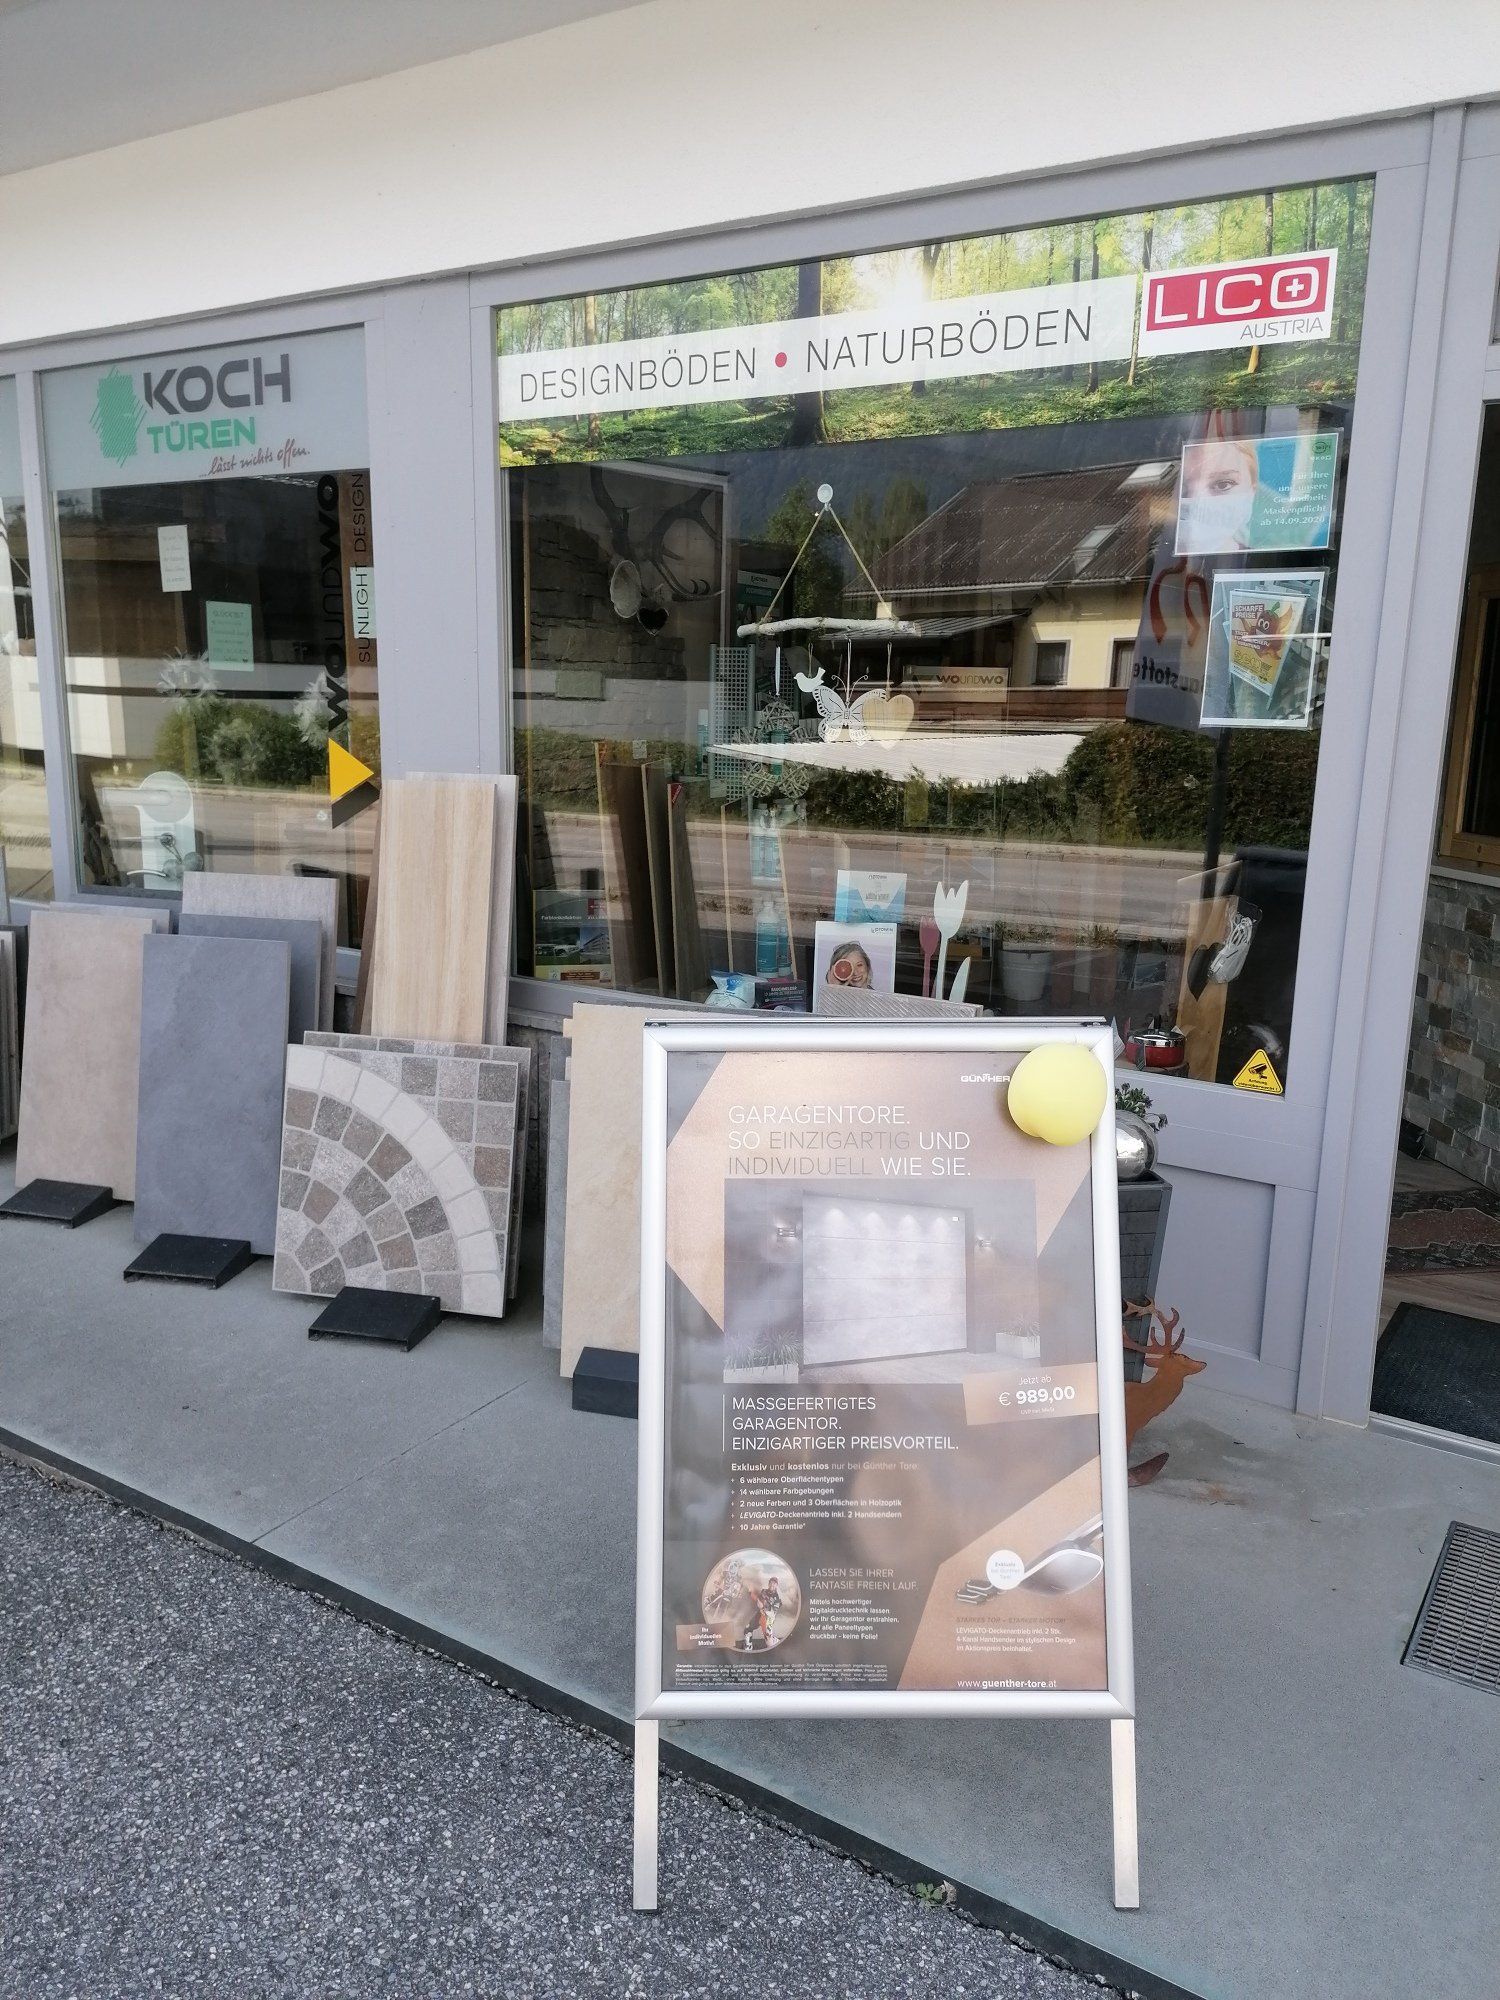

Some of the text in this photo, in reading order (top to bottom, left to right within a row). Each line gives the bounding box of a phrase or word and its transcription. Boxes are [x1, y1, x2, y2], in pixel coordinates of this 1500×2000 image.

[1154, 266, 1319, 323] LICO
[1240, 317, 1323, 340] AUSTRIA
[519, 304, 1093, 404] DESIGNBÖDEN NATURBÖDEN
[143, 354, 291, 415] KOCH
[147, 416, 256, 454] TÜREN
[240, 447, 273, 469] nichts
[277, 439, 310, 469] offen.
[1273, 494, 1327, 503] Gesundheit:
[1264, 505, 1326, 515] Maskenpflicht
[1261, 516, 1324, 526] ab 14.09.2020
[351, 473, 372, 663] SUNLIGHT DESIGN
[960, 1073, 1011, 1083] GÜNTHER
[728, 1105, 911, 1125] GARAGENTORE.
[729, 1131, 971, 1150] SO EINZIGARTIG UND
[729, 1157, 971, 1176] INDIVIDUELL WIE SIE.
[1019, 1375, 1051, 1385] Jetzt ab
[998, 1385, 1075, 1406] € 989,00
[732, 1397, 876, 1411] MASSGEFERTIGTES
[732, 1417, 842, 1430] GARAGENTOR.
[732, 1436, 960, 1450] EINZIGARTIGER PREISVORTEIL.
[731, 1463, 767, 1471] Exklusiv
[770, 1463, 785, 1471] und
[787, 1462, 829, 1470] kostenlos
[863, 1462, 897, 1470] Günther
[781, 1476, 844, 1484] Oberflächentypen
[783, 1487, 834, 1496] Farbgebungen
[766, 1499, 791, 1507] Farben
[793, 1499, 806, 1507] und
[815, 1499, 859, 1507] Oberflächen
[868, 1499, 902, 1507] Holzoptik
[739, 1511, 830, 1519] LEVIGATO-Deckenantrieb
[750, 1523, 770, 1531] Jahre
[809, 1568, 894, 1578] LASSEN SIE IHRER
[809, 1581, 918, 1591] FANTASIE FREIEN LAUF.
[957, 1679, 1057, 1688] www.guenther-tore.at
